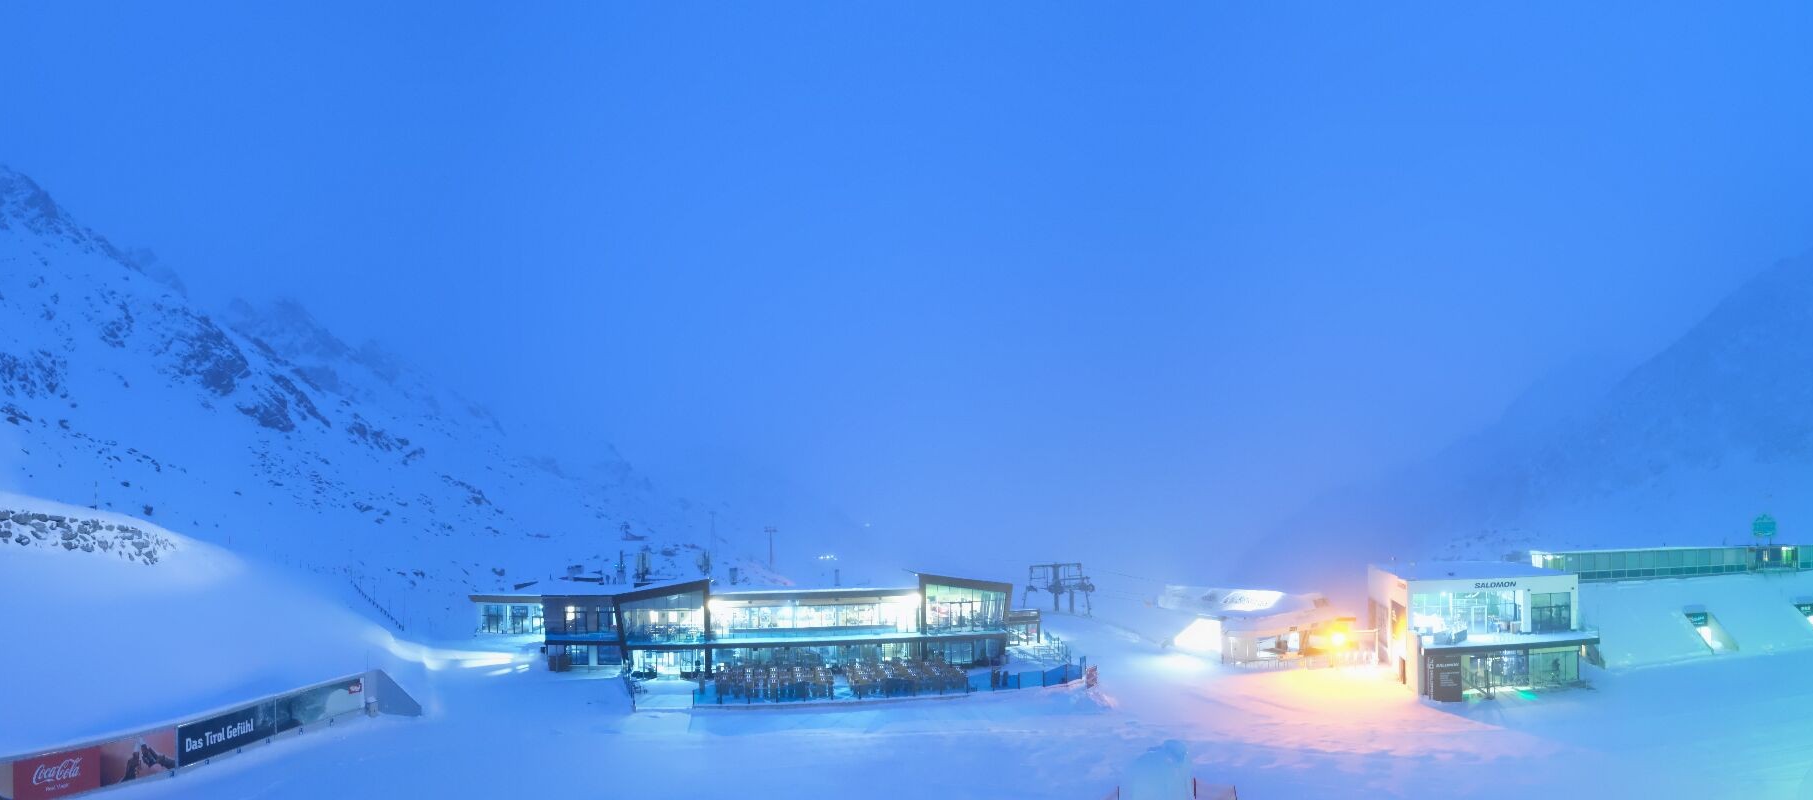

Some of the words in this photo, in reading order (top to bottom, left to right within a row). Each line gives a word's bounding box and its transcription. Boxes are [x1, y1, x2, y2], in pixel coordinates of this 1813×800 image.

[1474, 581, 1517, 589] SALOMON
[185, 737, 203, 752] Das
[204, 727, 225, 746] Tirol
[226, 718, 254, 739] Gefühl
